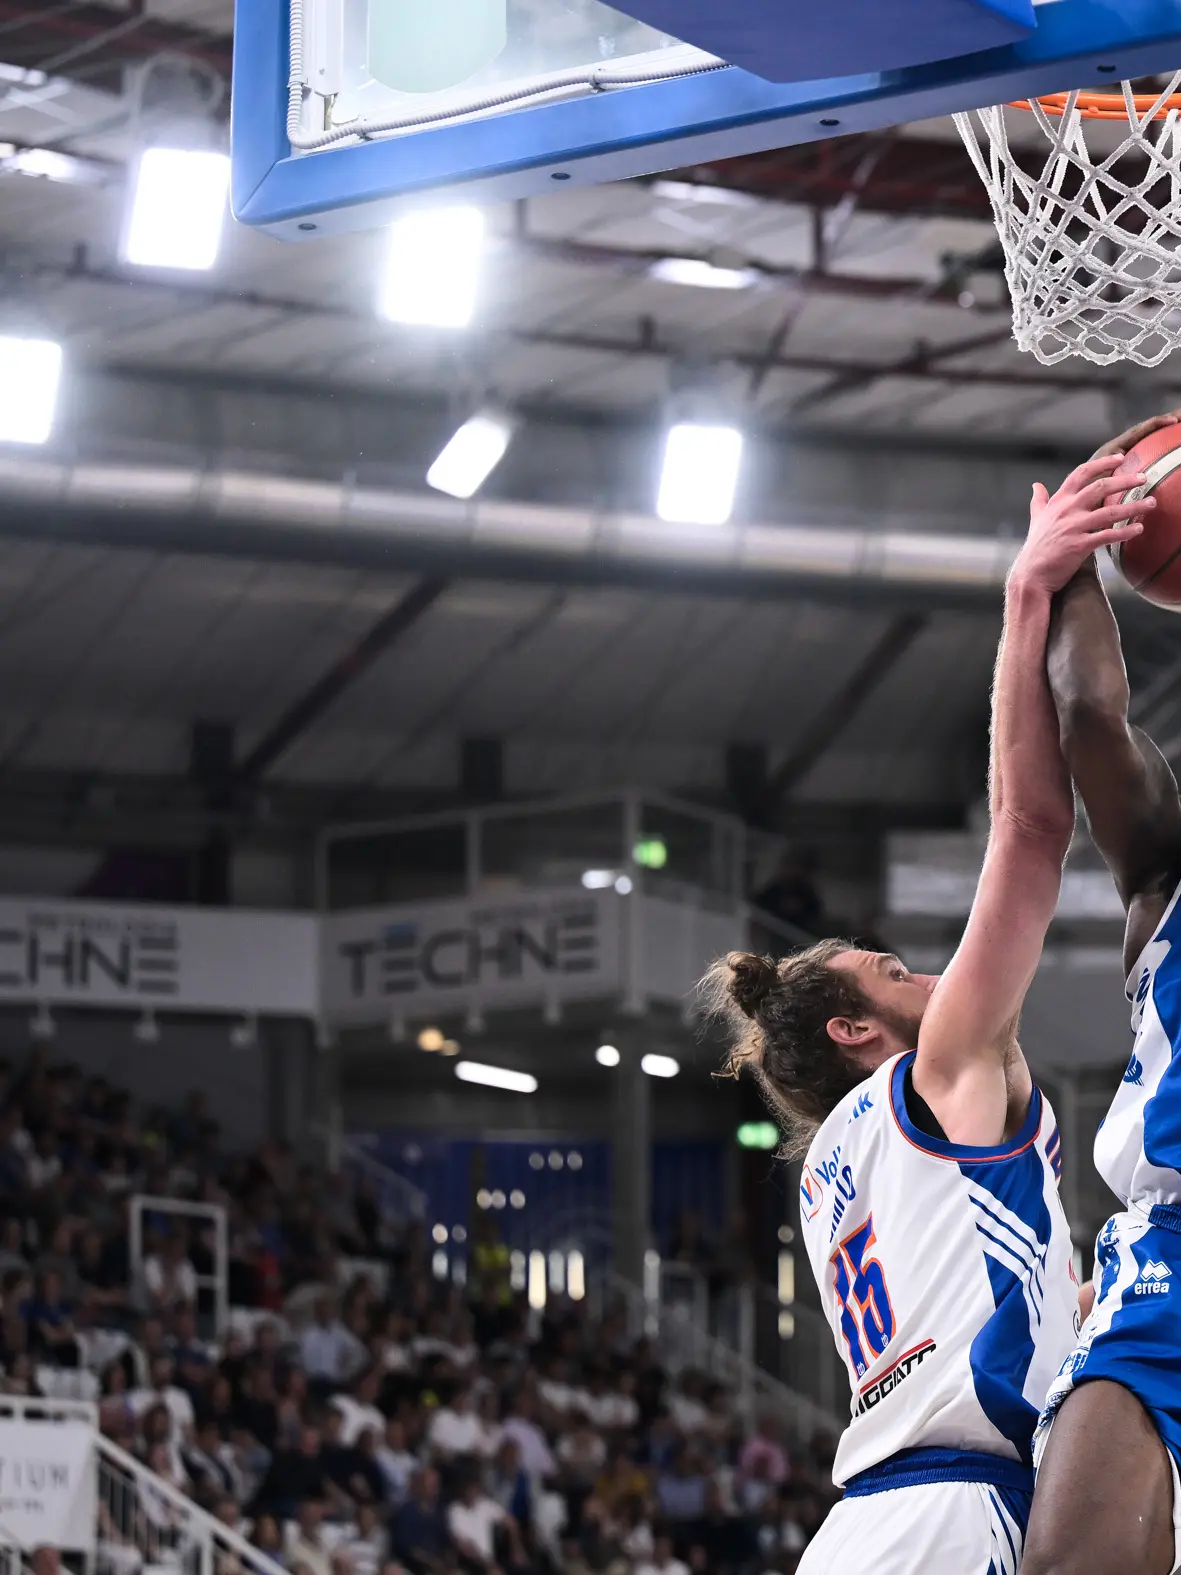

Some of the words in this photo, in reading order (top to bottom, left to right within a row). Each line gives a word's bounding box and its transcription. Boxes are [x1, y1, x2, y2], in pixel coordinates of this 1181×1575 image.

[339, 910, 599, 997] TECHNE
[829, 1210, 897, 1383] 15
[1135, 1282, 1170, 1295] errea
